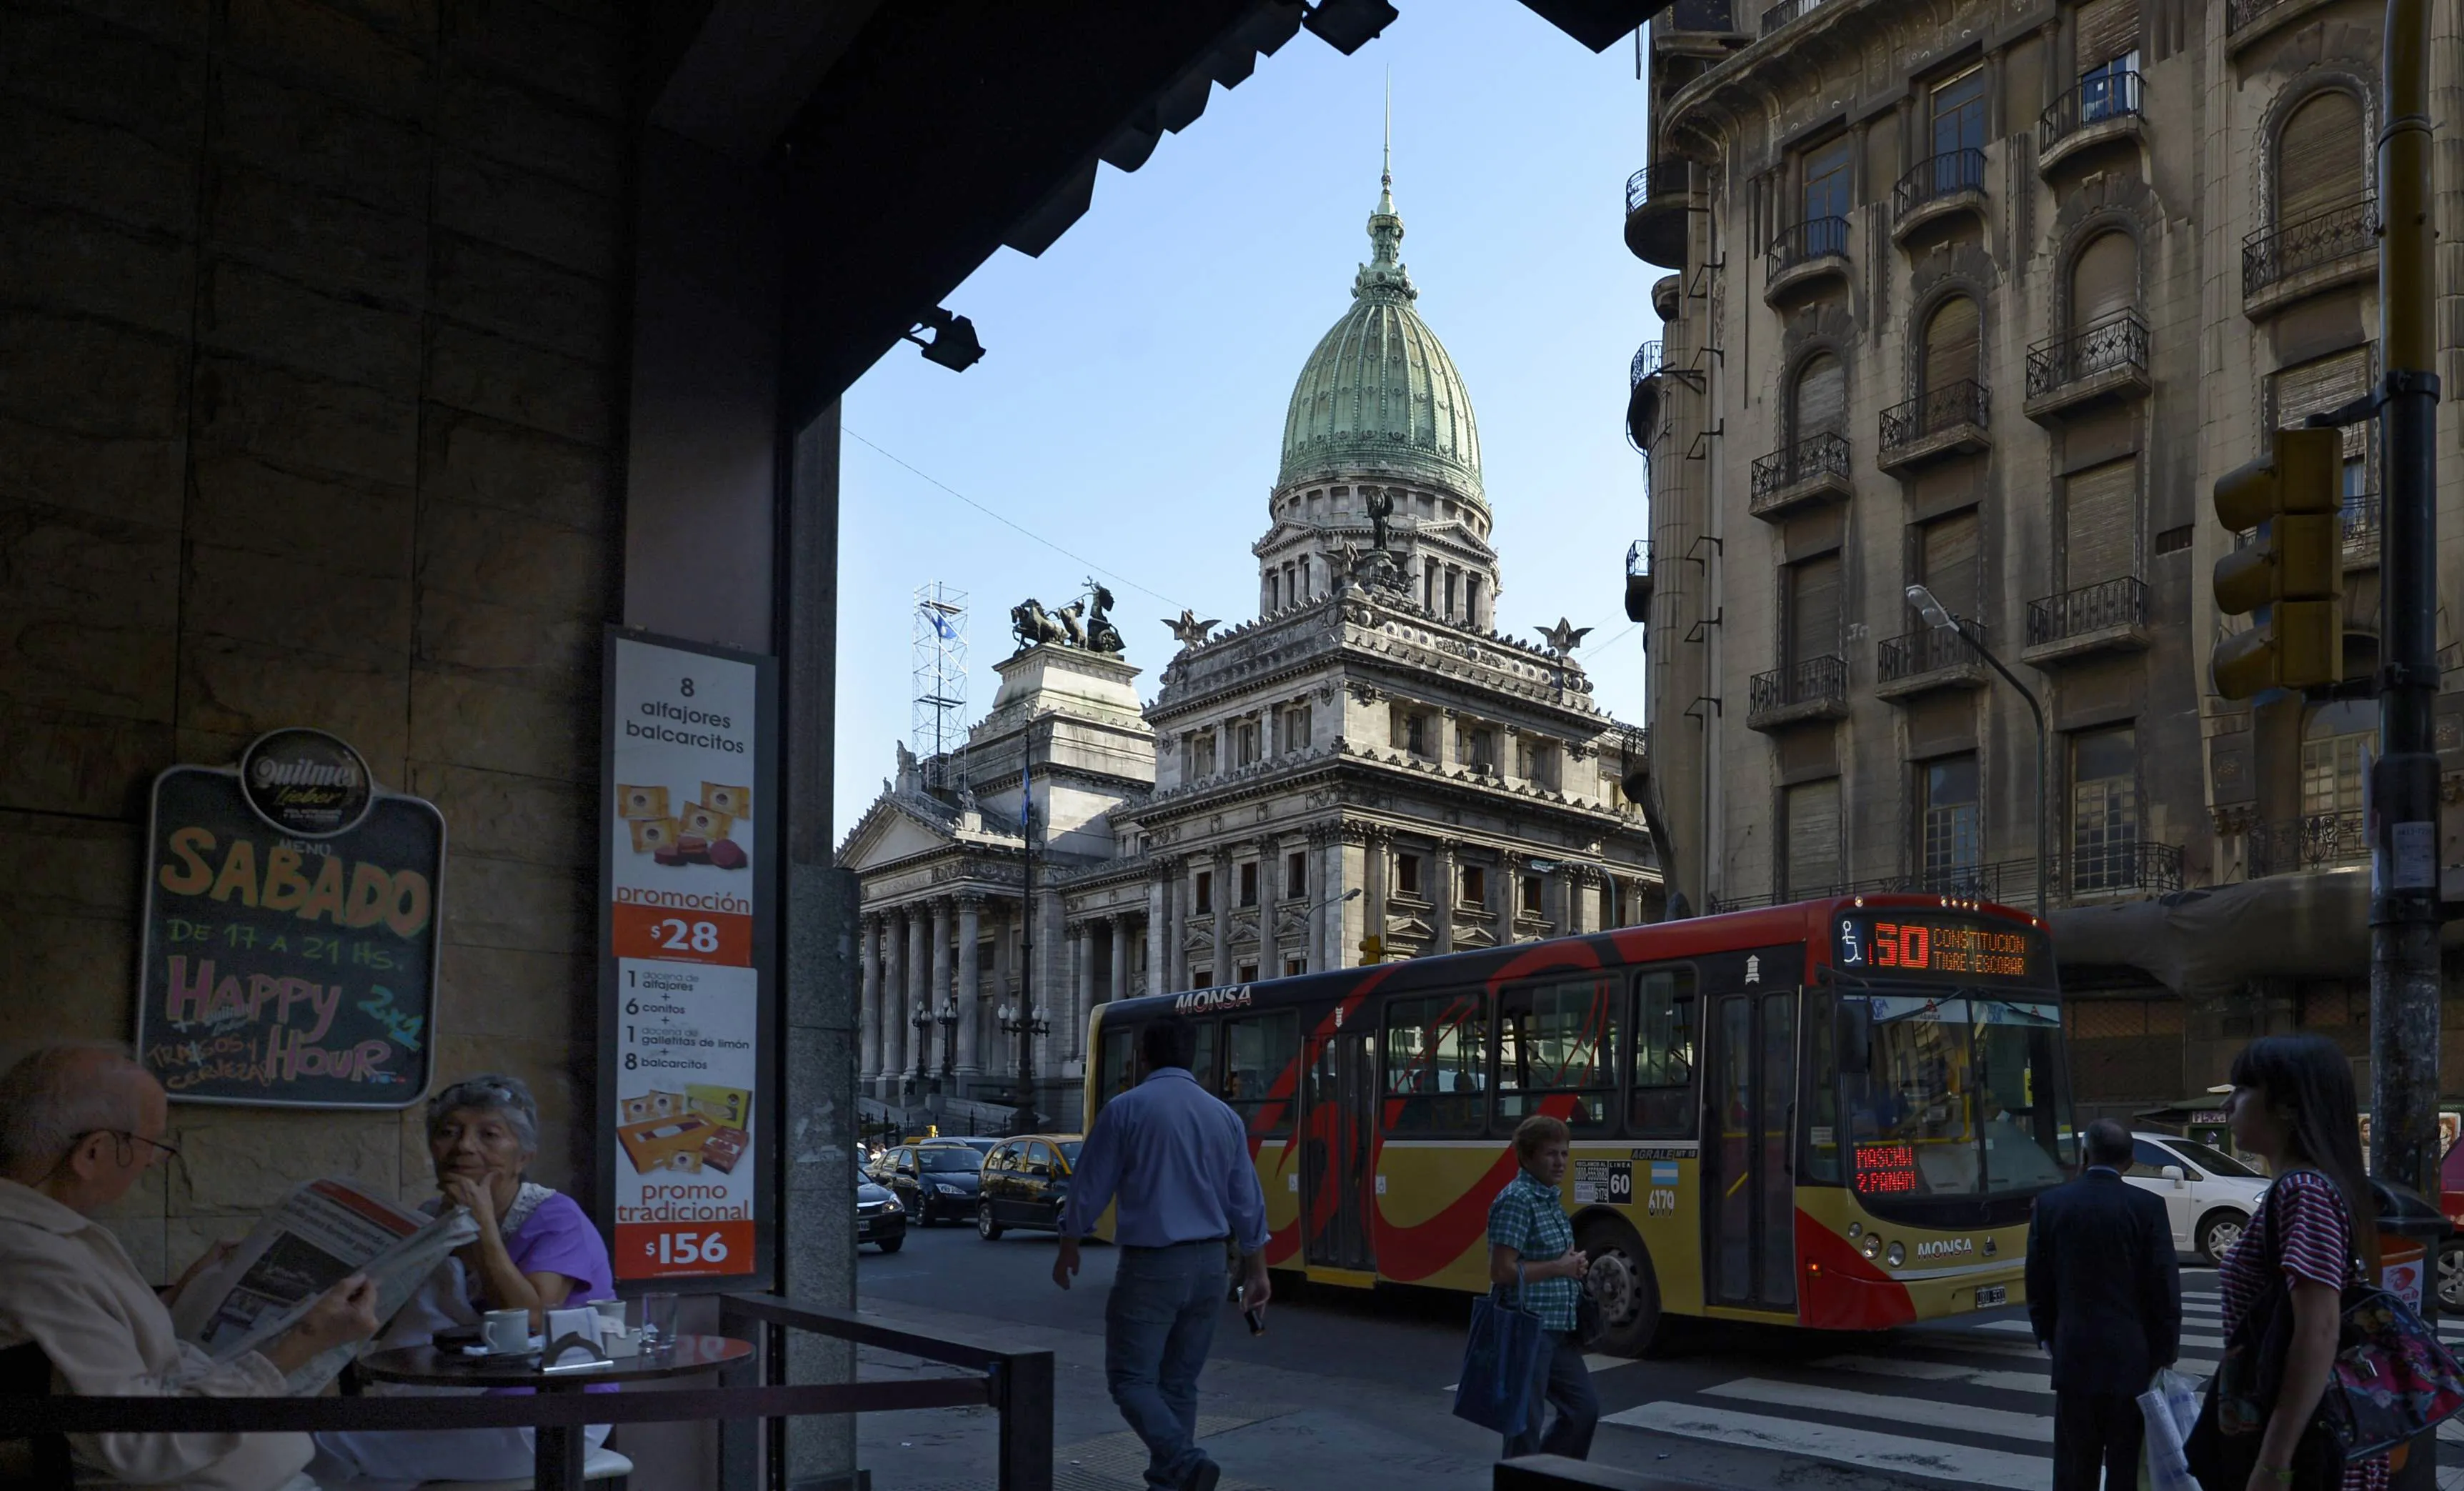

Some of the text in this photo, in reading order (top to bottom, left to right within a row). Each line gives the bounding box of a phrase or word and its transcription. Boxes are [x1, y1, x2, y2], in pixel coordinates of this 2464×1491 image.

[681, 677, 694, 697] 8
[641, 701, 732, 729] alfajores
[626, 719, 744, 754] balcarcitos
[158, 826, 429, 939] SABADO
[616, 886, 750, 914] promoción
[650, 918, 719, 953] $28
[1932, 927, 2025, 954] CONSTITUCION
[303, 937, 339, 964] 21
[627, 969, 636, 988] 1
[642, 979, 694, 992] alfajores
[625, 997, 686, 1015] 6 conitos
[1174, 984, 1252, 1015] MONSA
[627, 1025, 635, 1043] 1
[642, 1035, 750, 1050] galletitas de limón
[624, 1052, 708, 1070] 8 balcarcitos
[1632, 1149, 1674, 1160] AGRALE
[642, 1183, 728, 1205] promo
[1610, 1173, 1630, 1195] 60
[617, 1200, 750, 1223] tradicional
[1648, 1189, 1675, 1217] 6179
[644, 1231, 729, 1264] $156
[1917, 1238, 1973, 1260] MONSA
